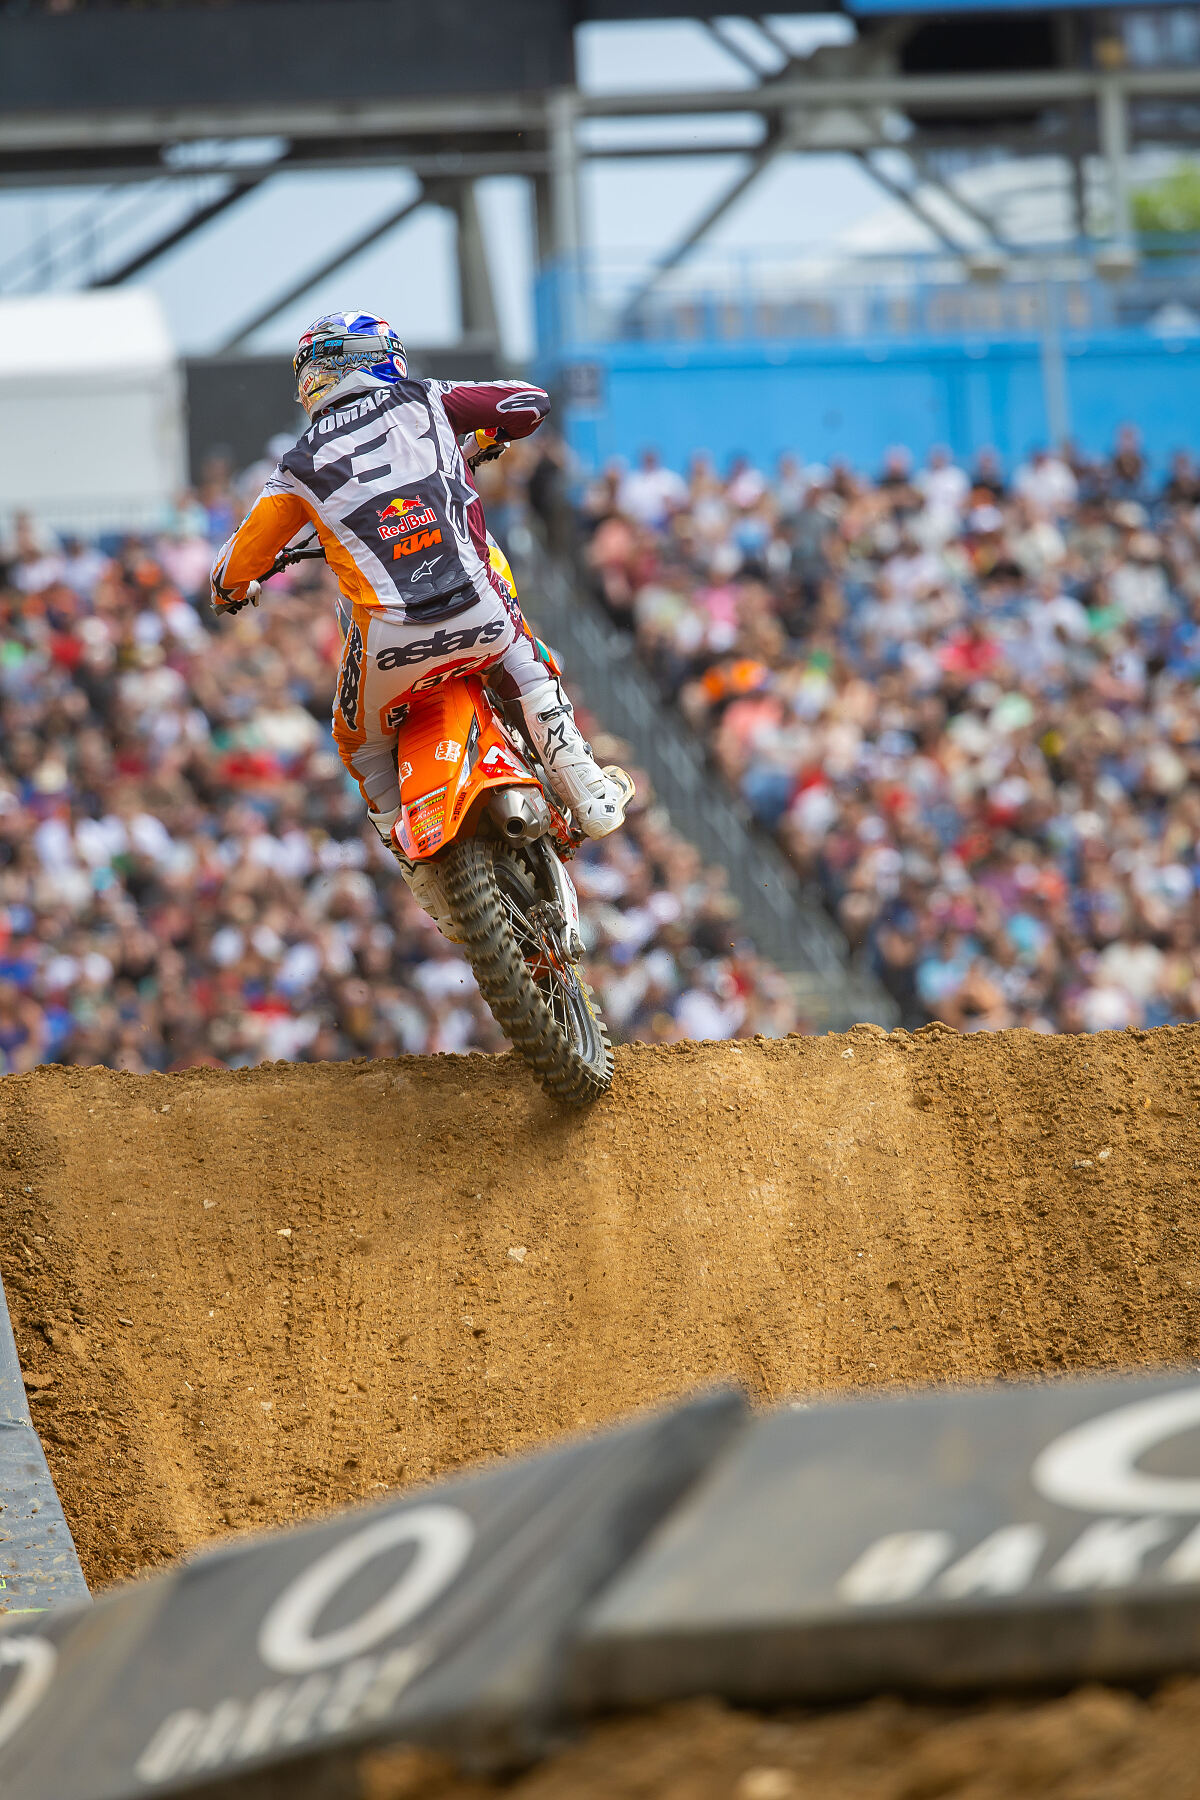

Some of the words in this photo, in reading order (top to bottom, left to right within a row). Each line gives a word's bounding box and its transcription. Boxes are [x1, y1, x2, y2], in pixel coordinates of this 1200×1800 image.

[329, 351, 379, 369] TOMAC
[302, 375, 314, 392] BELL
[304, 388, 391, 445] TOMAC
[312, 400, 438, 518] 3
[377, 516, 411, 540] Red
[406, 507, 438, 530] Bull
[393, 528, 443, 560] KTM
[375, 619, 505, 671] astars
